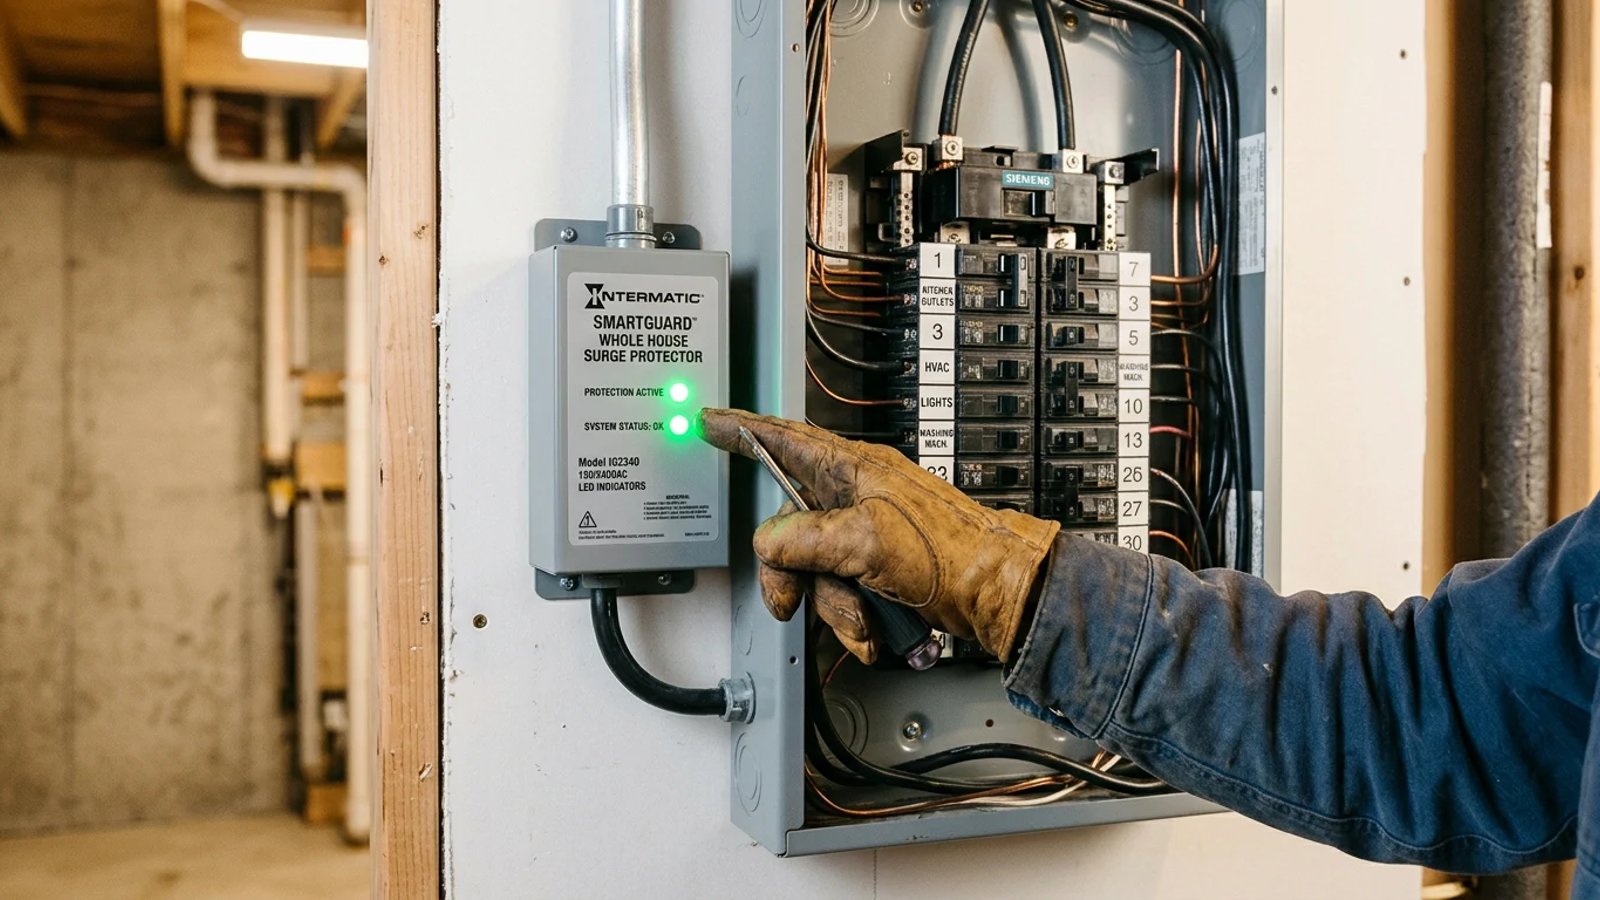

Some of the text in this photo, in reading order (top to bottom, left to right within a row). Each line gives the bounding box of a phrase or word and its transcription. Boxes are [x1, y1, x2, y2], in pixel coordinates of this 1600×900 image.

[934, 252, 941, 269] 1
[1128, 261, 1139, 277] 7
[584, 283, 701, 310] INTERMATIC
[1128, 295, 1139, 312] 3
[599, 333, 689, 348] WHOLE HOUSE
[932, 323, 943, 341] 3
[1128, 329, 1139, 346] 5
[583, 348, 703, 363] SURGE PROTECTOR
[924, 361, 950, 373] HVAC
[584, 387, 664, 397] PROTECTION ACTIVE
[920, 396, 953, 408] LIGHTS
[1124, 398, 1143, 415] 10
[618, 421, 652, 431] STATUS:
[652, 421, 664, 431] OK
[1124, 431, 1143, 449] 13
[578, 456, 640, 468] Model IG2340
[1122, 466, 1143, 483] 26
[578, 481, 646, 492] LED INDICATORS
[1122, 500, 1142, 517] 27
[1122, 534, 1142, 551] 30
